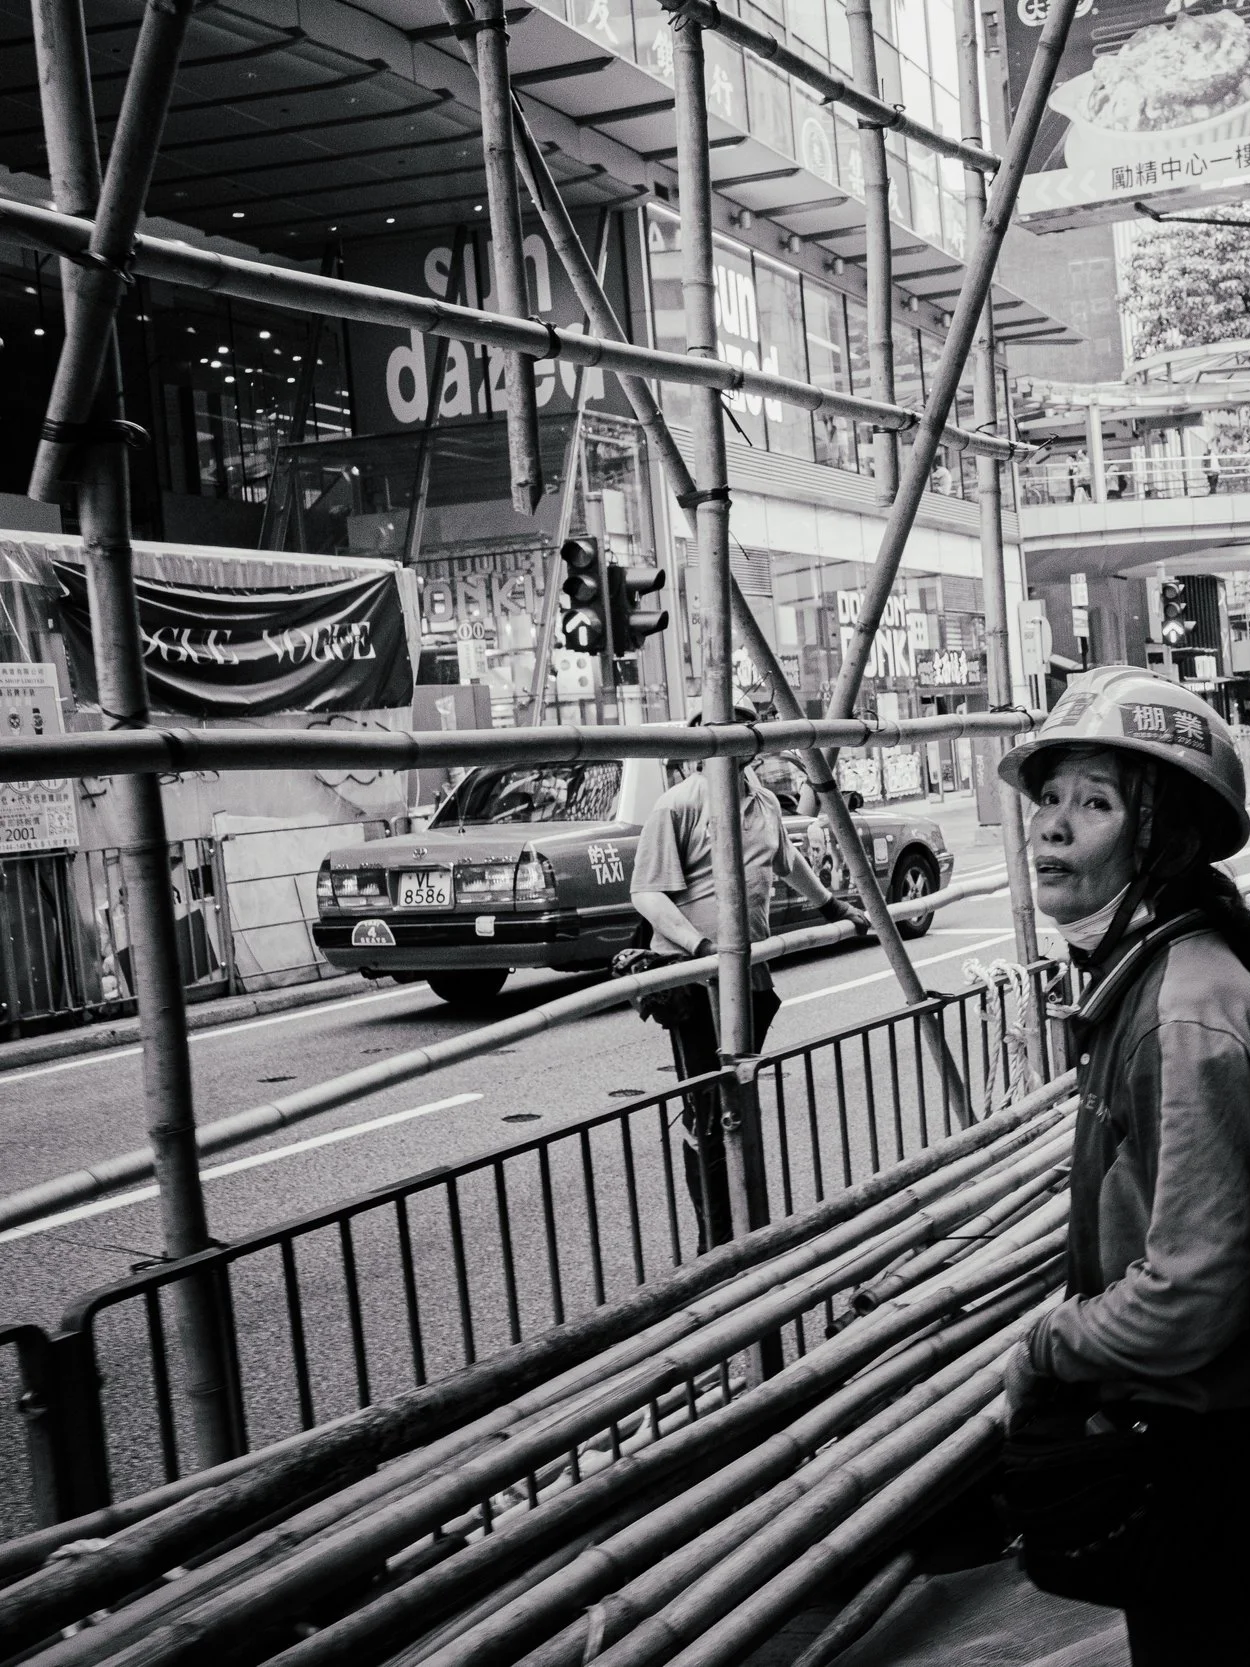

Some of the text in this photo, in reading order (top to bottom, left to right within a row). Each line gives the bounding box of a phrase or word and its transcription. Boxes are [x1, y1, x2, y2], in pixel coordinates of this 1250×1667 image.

[1132, 705, 1204, 740] 棚業
[5, 827, 37, 842] 2001
[588, 843, 620, 865] 的士
[415, 873, 435, 888] VL
[591, 861, 625, 885] TAXI
[404, 889, 446, 904] 8586
[367, 926, 377, 938] 4
